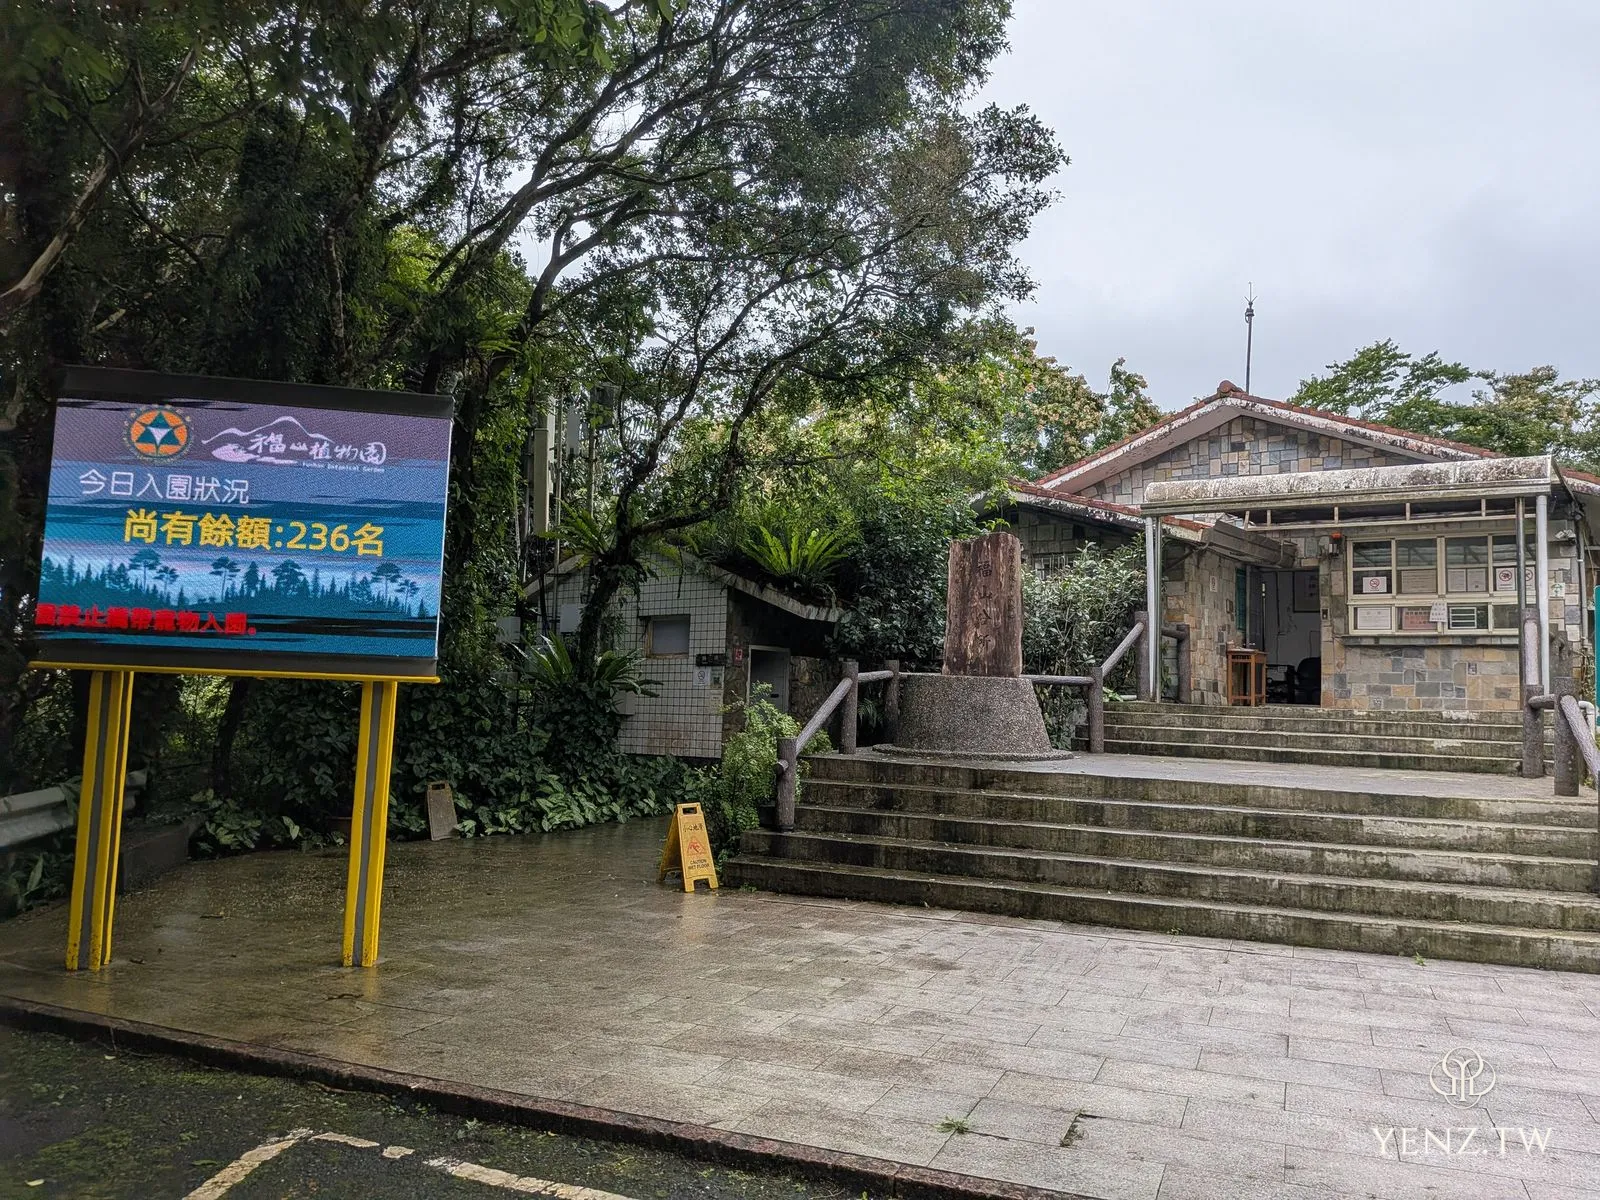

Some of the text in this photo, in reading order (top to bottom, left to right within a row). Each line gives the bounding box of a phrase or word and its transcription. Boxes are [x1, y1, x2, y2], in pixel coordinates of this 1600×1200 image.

[249, 431, 387, 465] 福山植物園
[79, 468, 250, 505] 今日入園狀況
[124, 508, 385, 557] 尚有餘額:236名
